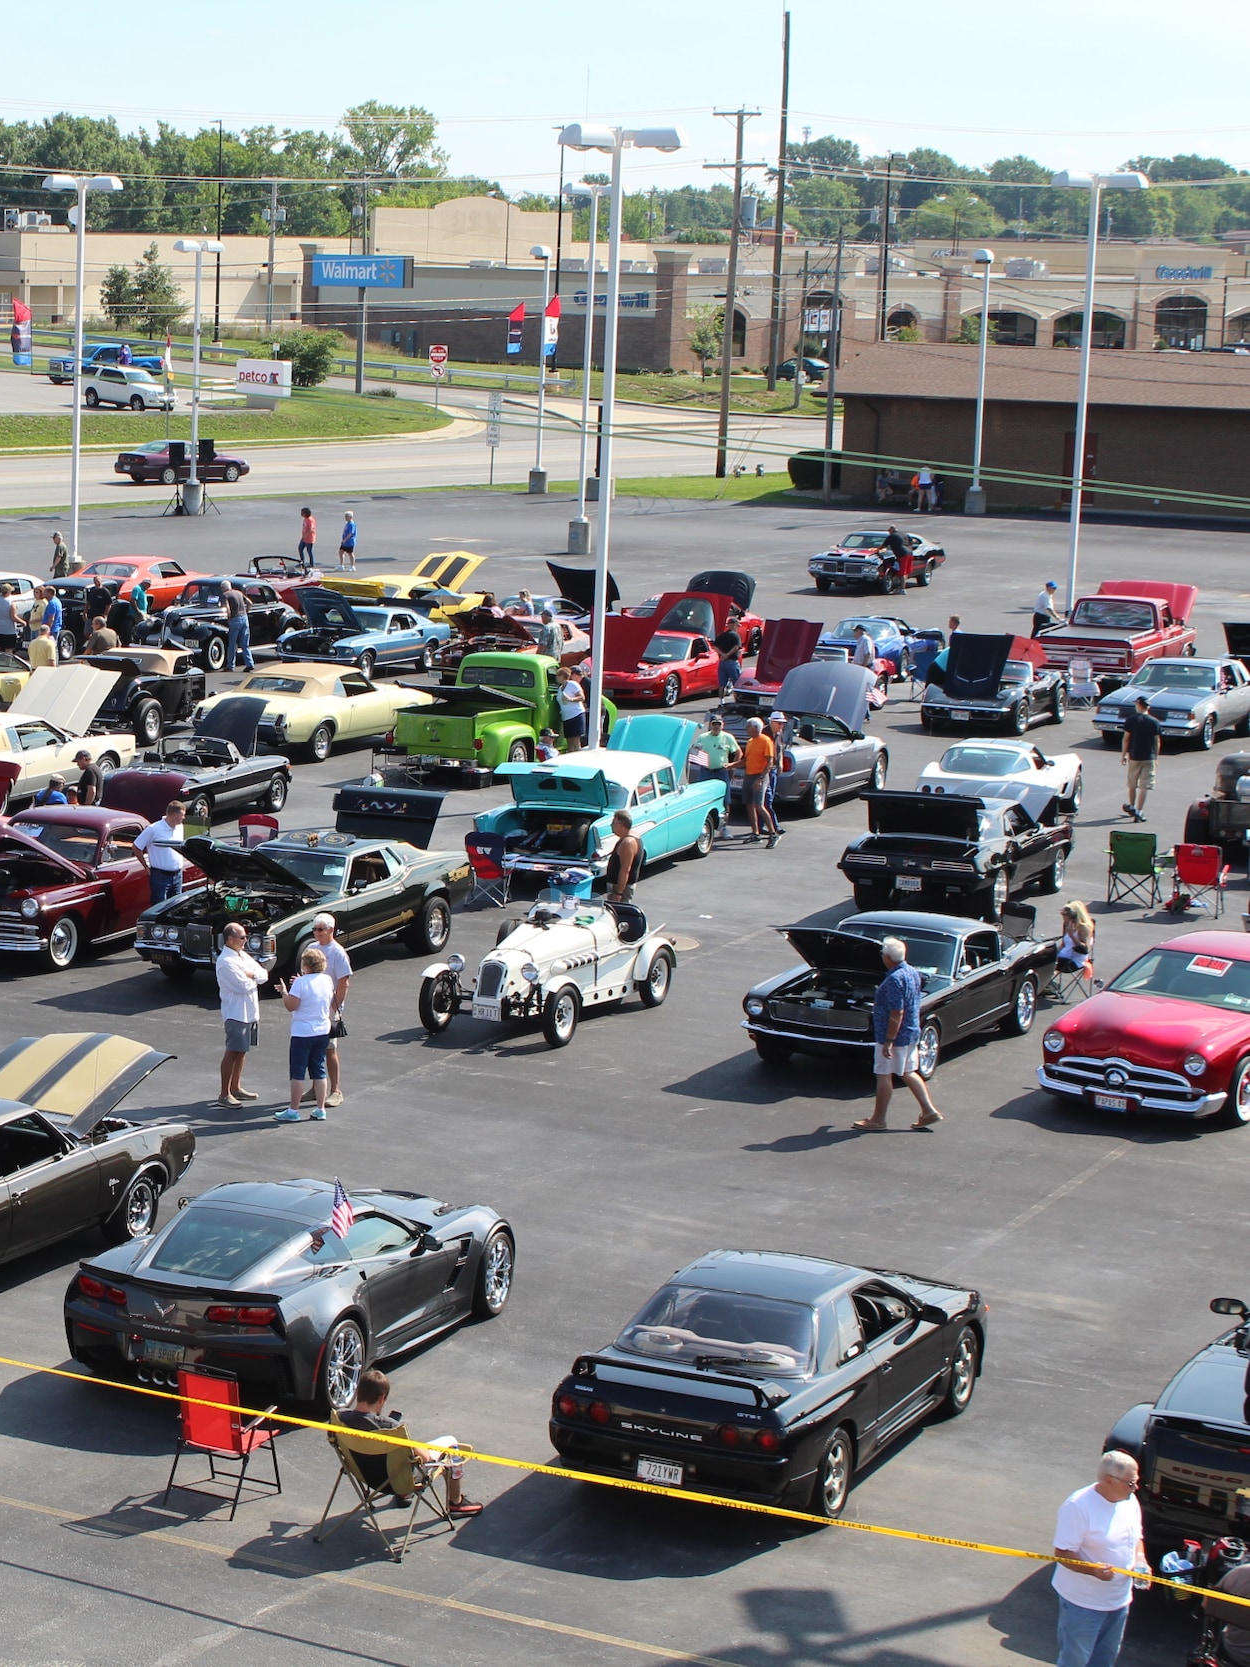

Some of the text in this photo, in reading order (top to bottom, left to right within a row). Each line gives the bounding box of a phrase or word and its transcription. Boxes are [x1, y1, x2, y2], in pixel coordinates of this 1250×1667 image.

[321, 261, 377, 280] Walmart
[1155, 264, 1213, 280] Goodwill
[239, 369, 268, 383] petco
[620, 1421, 703, 1442] SKYLINE
[646, 1462, 680, 1480] 721YWR
